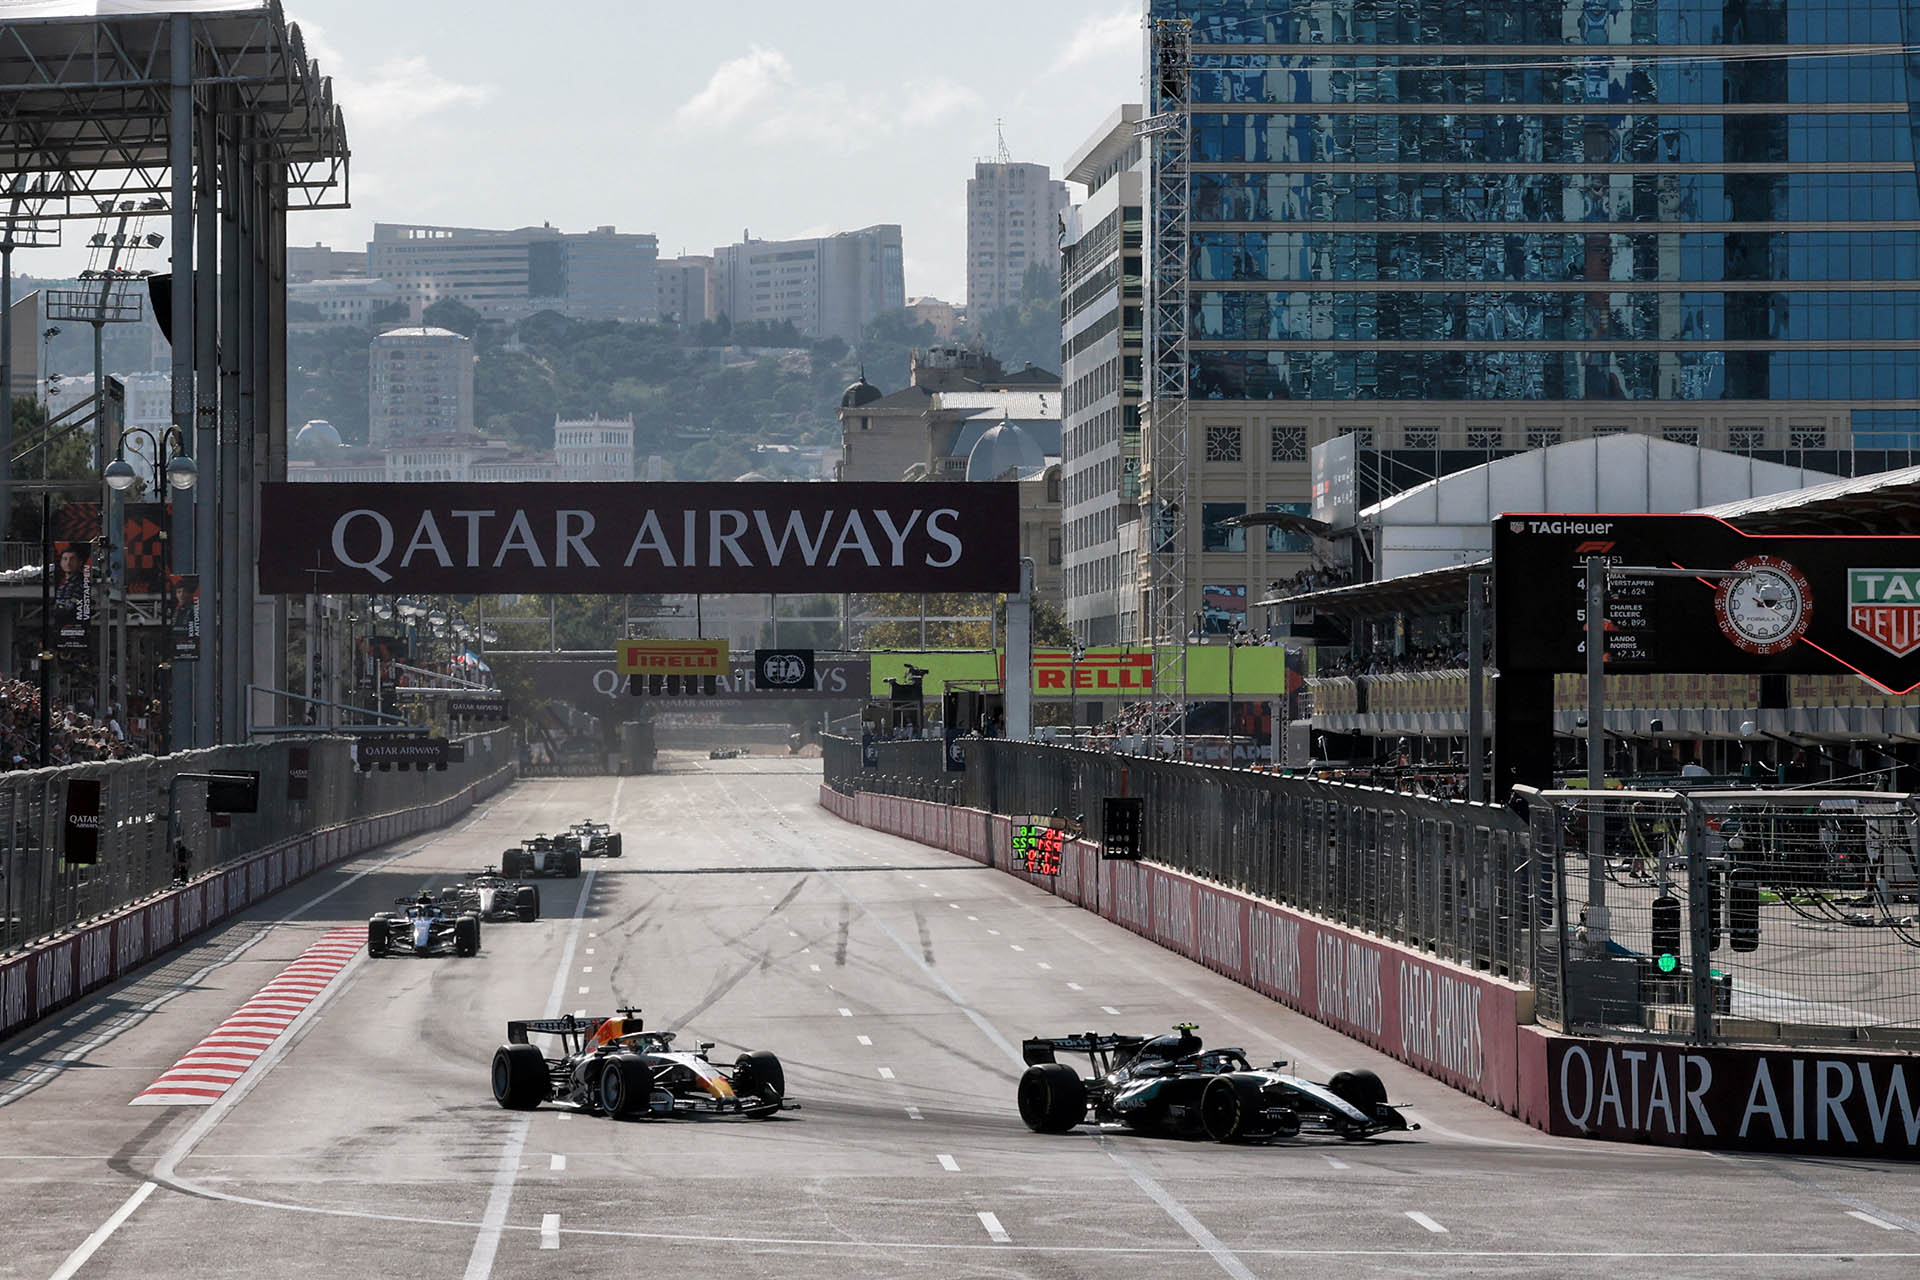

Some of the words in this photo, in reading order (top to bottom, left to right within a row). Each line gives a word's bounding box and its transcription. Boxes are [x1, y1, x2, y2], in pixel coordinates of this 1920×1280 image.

[331, 509, 600, 583] QATAR
[623, 509, 963, 568] AIRWAYS
[83, 565, 91, 621] VERSTAPPEN
[1577, 578, 1585, 589] 4
[1857, 575, 1920, 600] TA
[1577, 610, 1585, 621] 5
[1577, 641, 1585, 652] 6
[627, 648, 718, 668] PIRELLI
[767, 661, 801, 677] FIA
[365, 747, 398, 755] QATAR
[399, 746, 441, 755] AIRWAYS
[70, 815, 98, 824] QATAR
[1316, 930, 1344, 1021] QATAR
[1346, 940, 1382, 1036] AIRWAYS
[1400, 960, 1433, 1062] QATAR
[1436, 972, 1482, 1083] AIRWAYS
[1560, 1046, 1717, 1136] QATAR
[1738, 1057, 1920, 1145] AIRW
